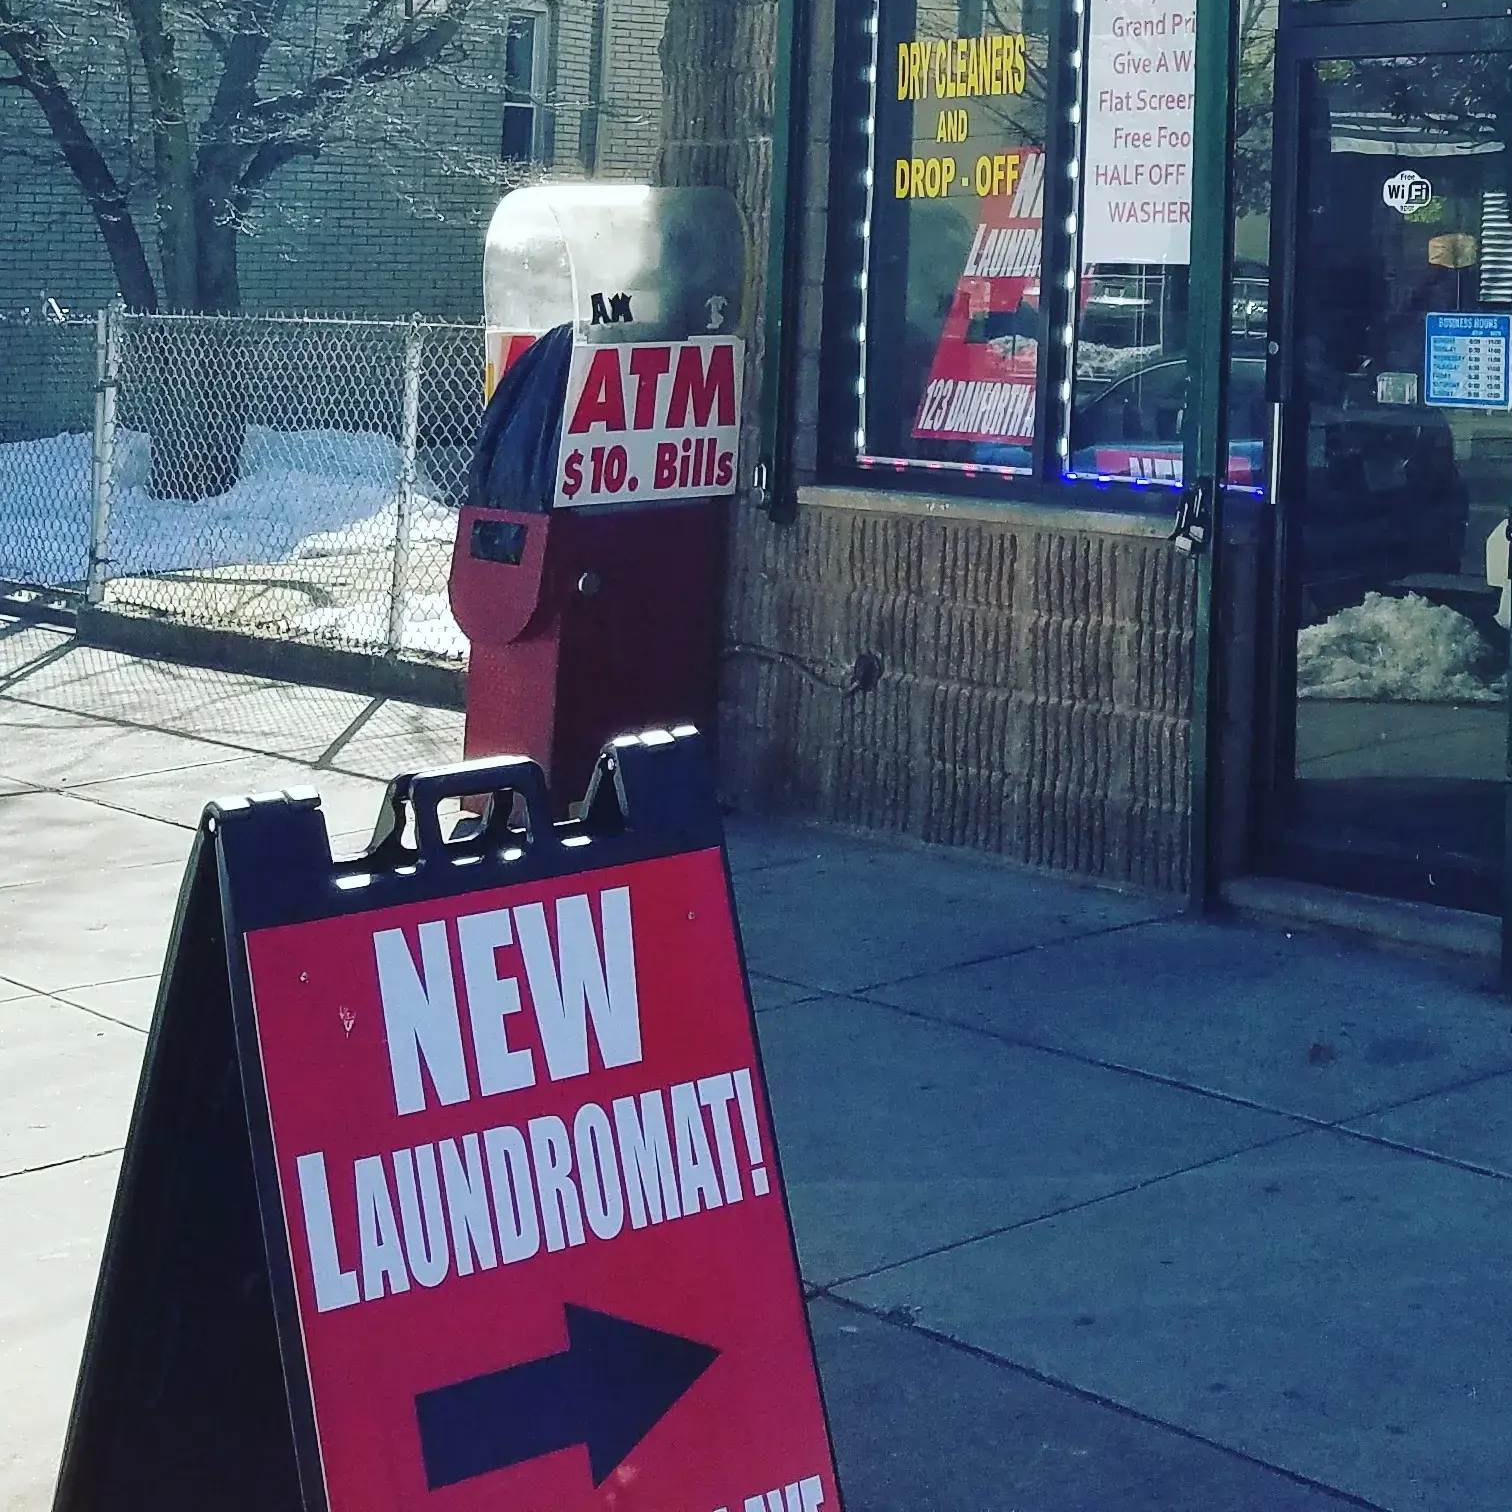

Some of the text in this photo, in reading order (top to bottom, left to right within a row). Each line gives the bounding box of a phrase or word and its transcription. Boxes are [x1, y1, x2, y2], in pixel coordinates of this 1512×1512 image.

[1112, 12, 1166, 38] Grand
[897, 33, 1027, 101] DRY CLEANERS
[1113, 50, 1152, 75] Give
[1156, 50, 1170, 73] A
[1099, 89, 1132, 112] Flat
[936, 108, 968, 144] AND
[1113, 127, 1152, 149] Free
[895, 157, 956, 199] DROP
[975, 154, 1020, 197] OFF
[1095, 163, 1187, 186] HALF OFF
[1108, 200, 1191, 224] WASHER
[963, 222, 1042, 278] LAUNDR
[567, 345, 737, 435] ATM
[917, 378, 954, 431] 123
[943, 380, 1032, 437] DANFORTH
[653, 437, 734, 491] Bills
[373, 886, 643, 1116] NEW
[295, 1068, 770, 1314] LAUNDROMAT!
